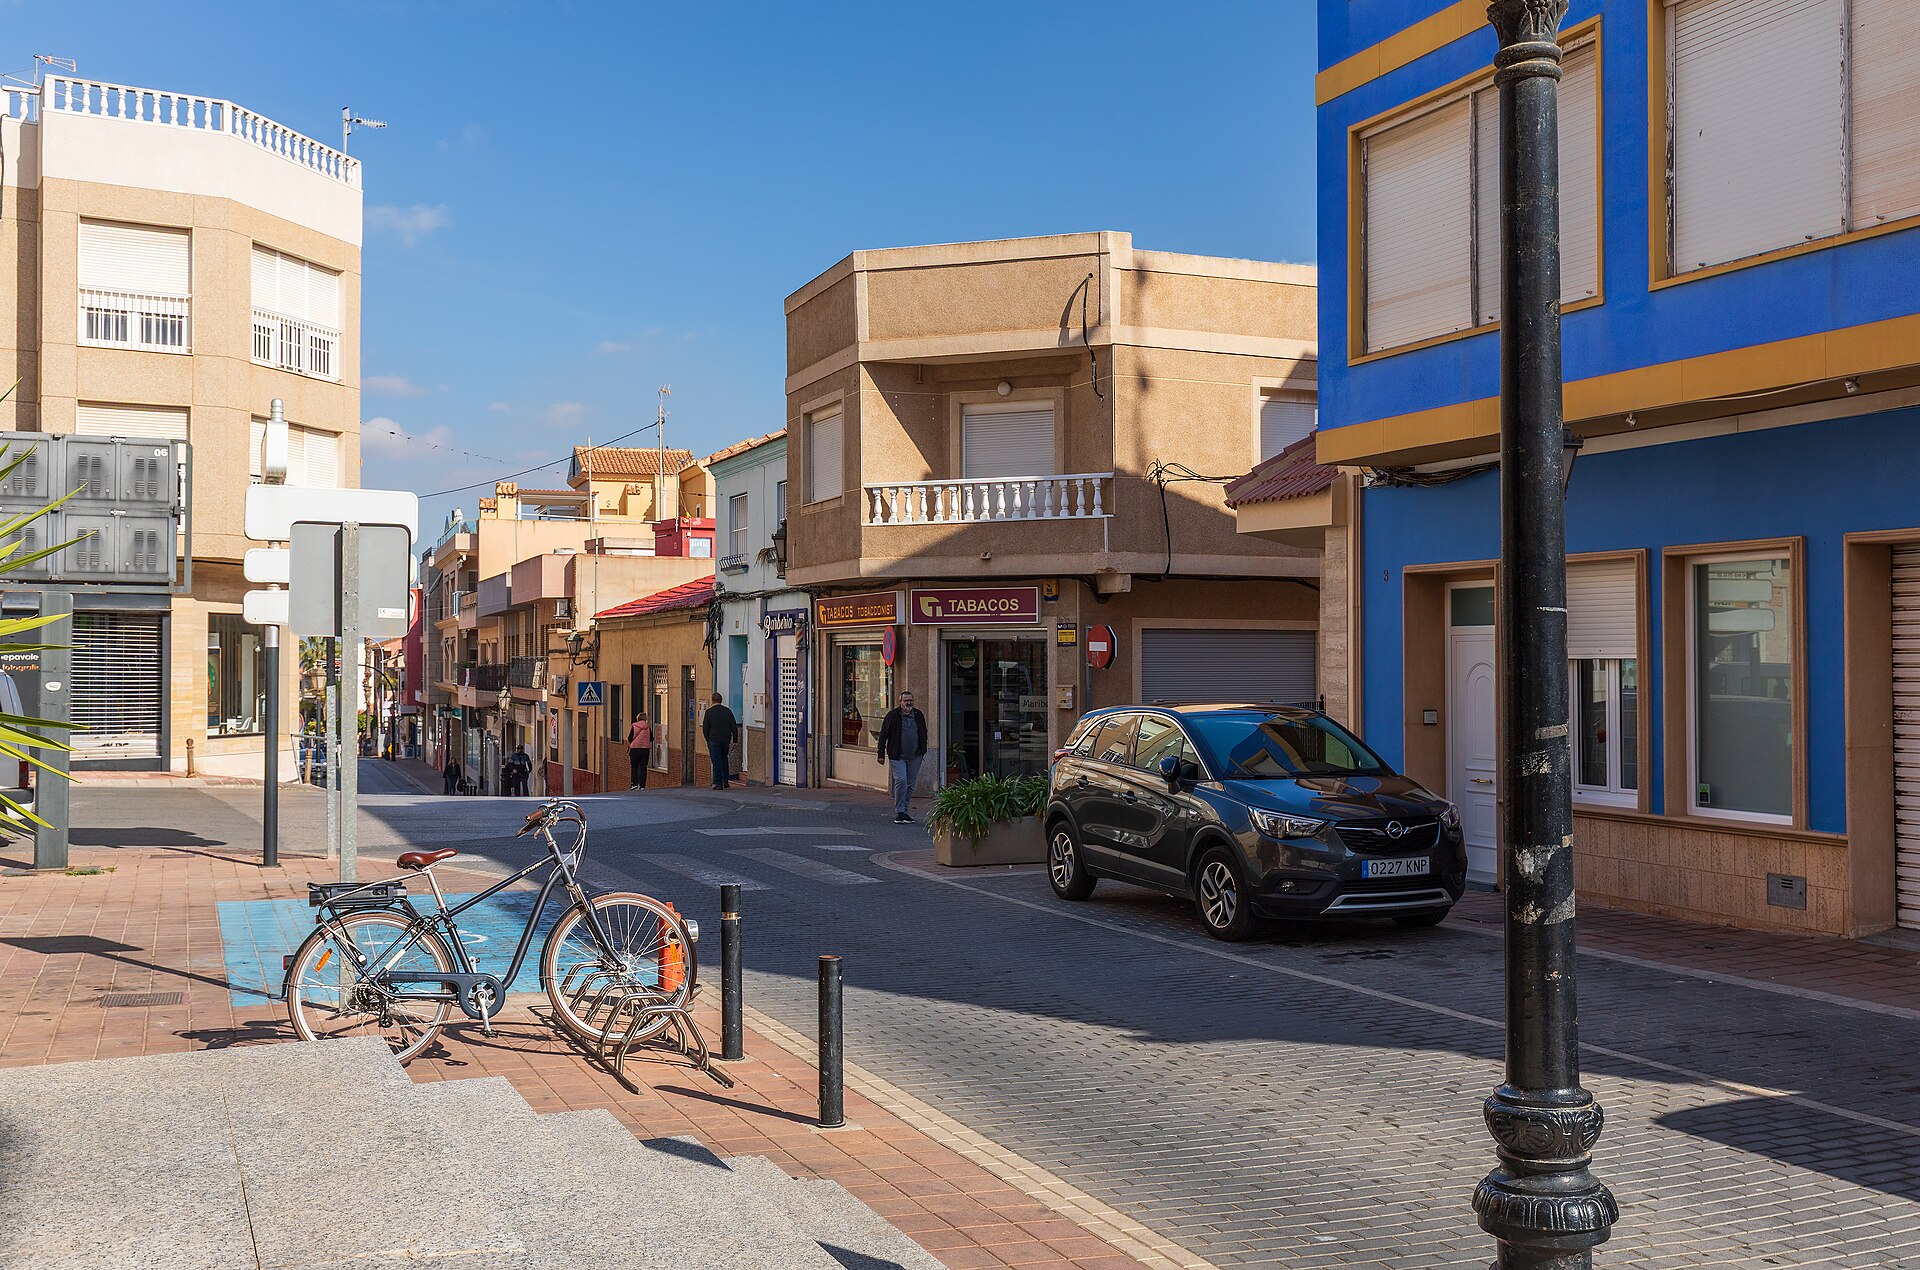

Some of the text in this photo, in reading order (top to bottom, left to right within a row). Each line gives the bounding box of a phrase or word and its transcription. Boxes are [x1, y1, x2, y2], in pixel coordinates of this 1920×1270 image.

[153, 448, 168, 457] 06
[1383, 569, 1389, 582] 3
[826, 604, 893, 619] TABACOS TOBACCONIST
[948, 598, 1019, 612] TABACOS
[1371, 861, 1402, 875] 0227
[1406, 859, 1427, 874] KNP
